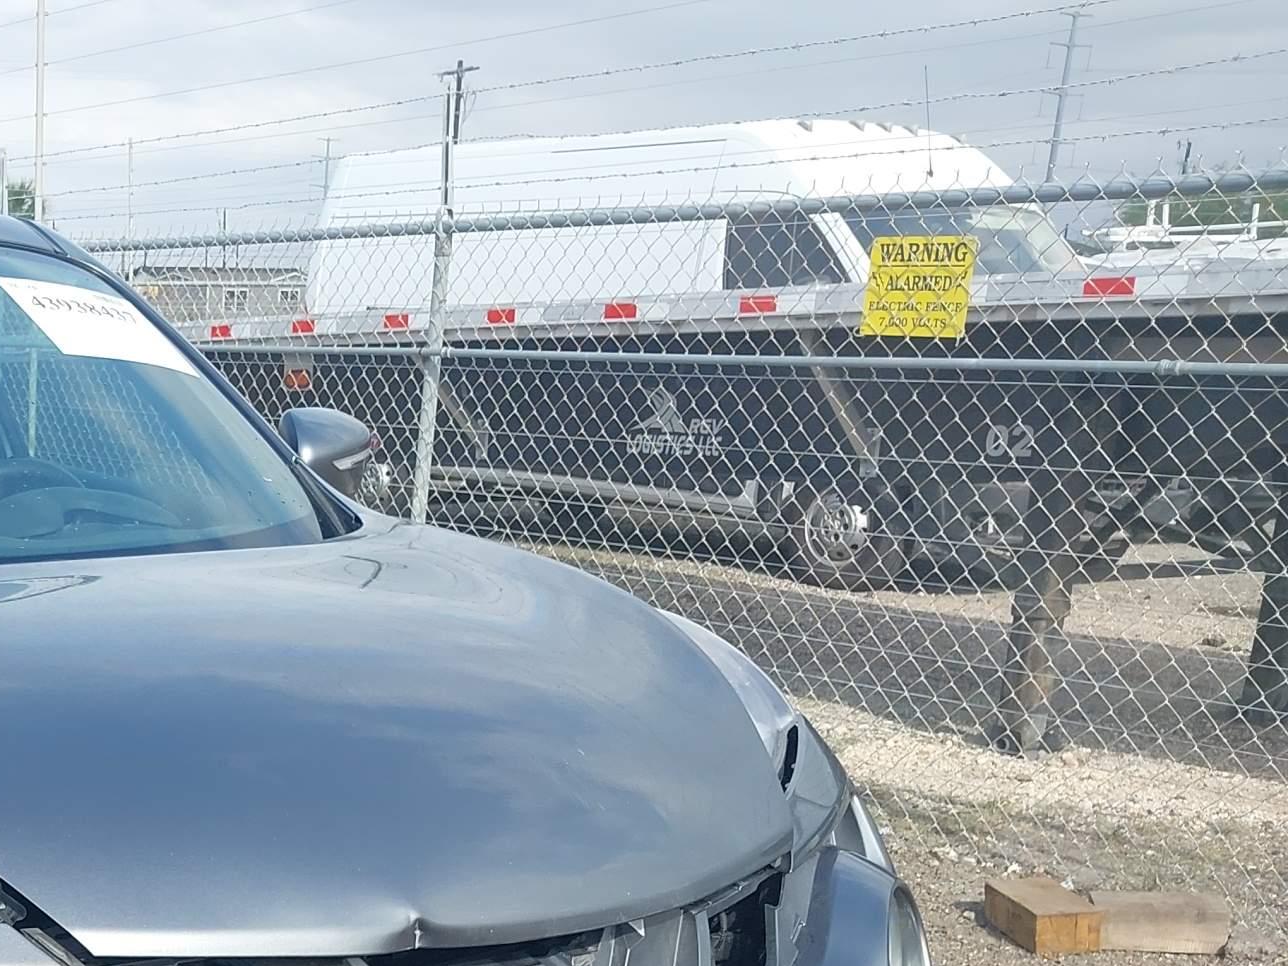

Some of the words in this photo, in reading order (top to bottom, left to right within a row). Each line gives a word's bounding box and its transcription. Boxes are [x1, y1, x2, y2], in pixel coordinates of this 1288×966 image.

[880, 242, 968, 263] WARNING
[885, 275, 953, 292] ALARMED
[31, 295, 137, 324] 43938437
[868, 300, 922, 312] ELECTRIC
[925, 302, 962, 313] FENCE
[911, 318, 947, 328] VOLTS
[985, 424, 1034, 457] 02
